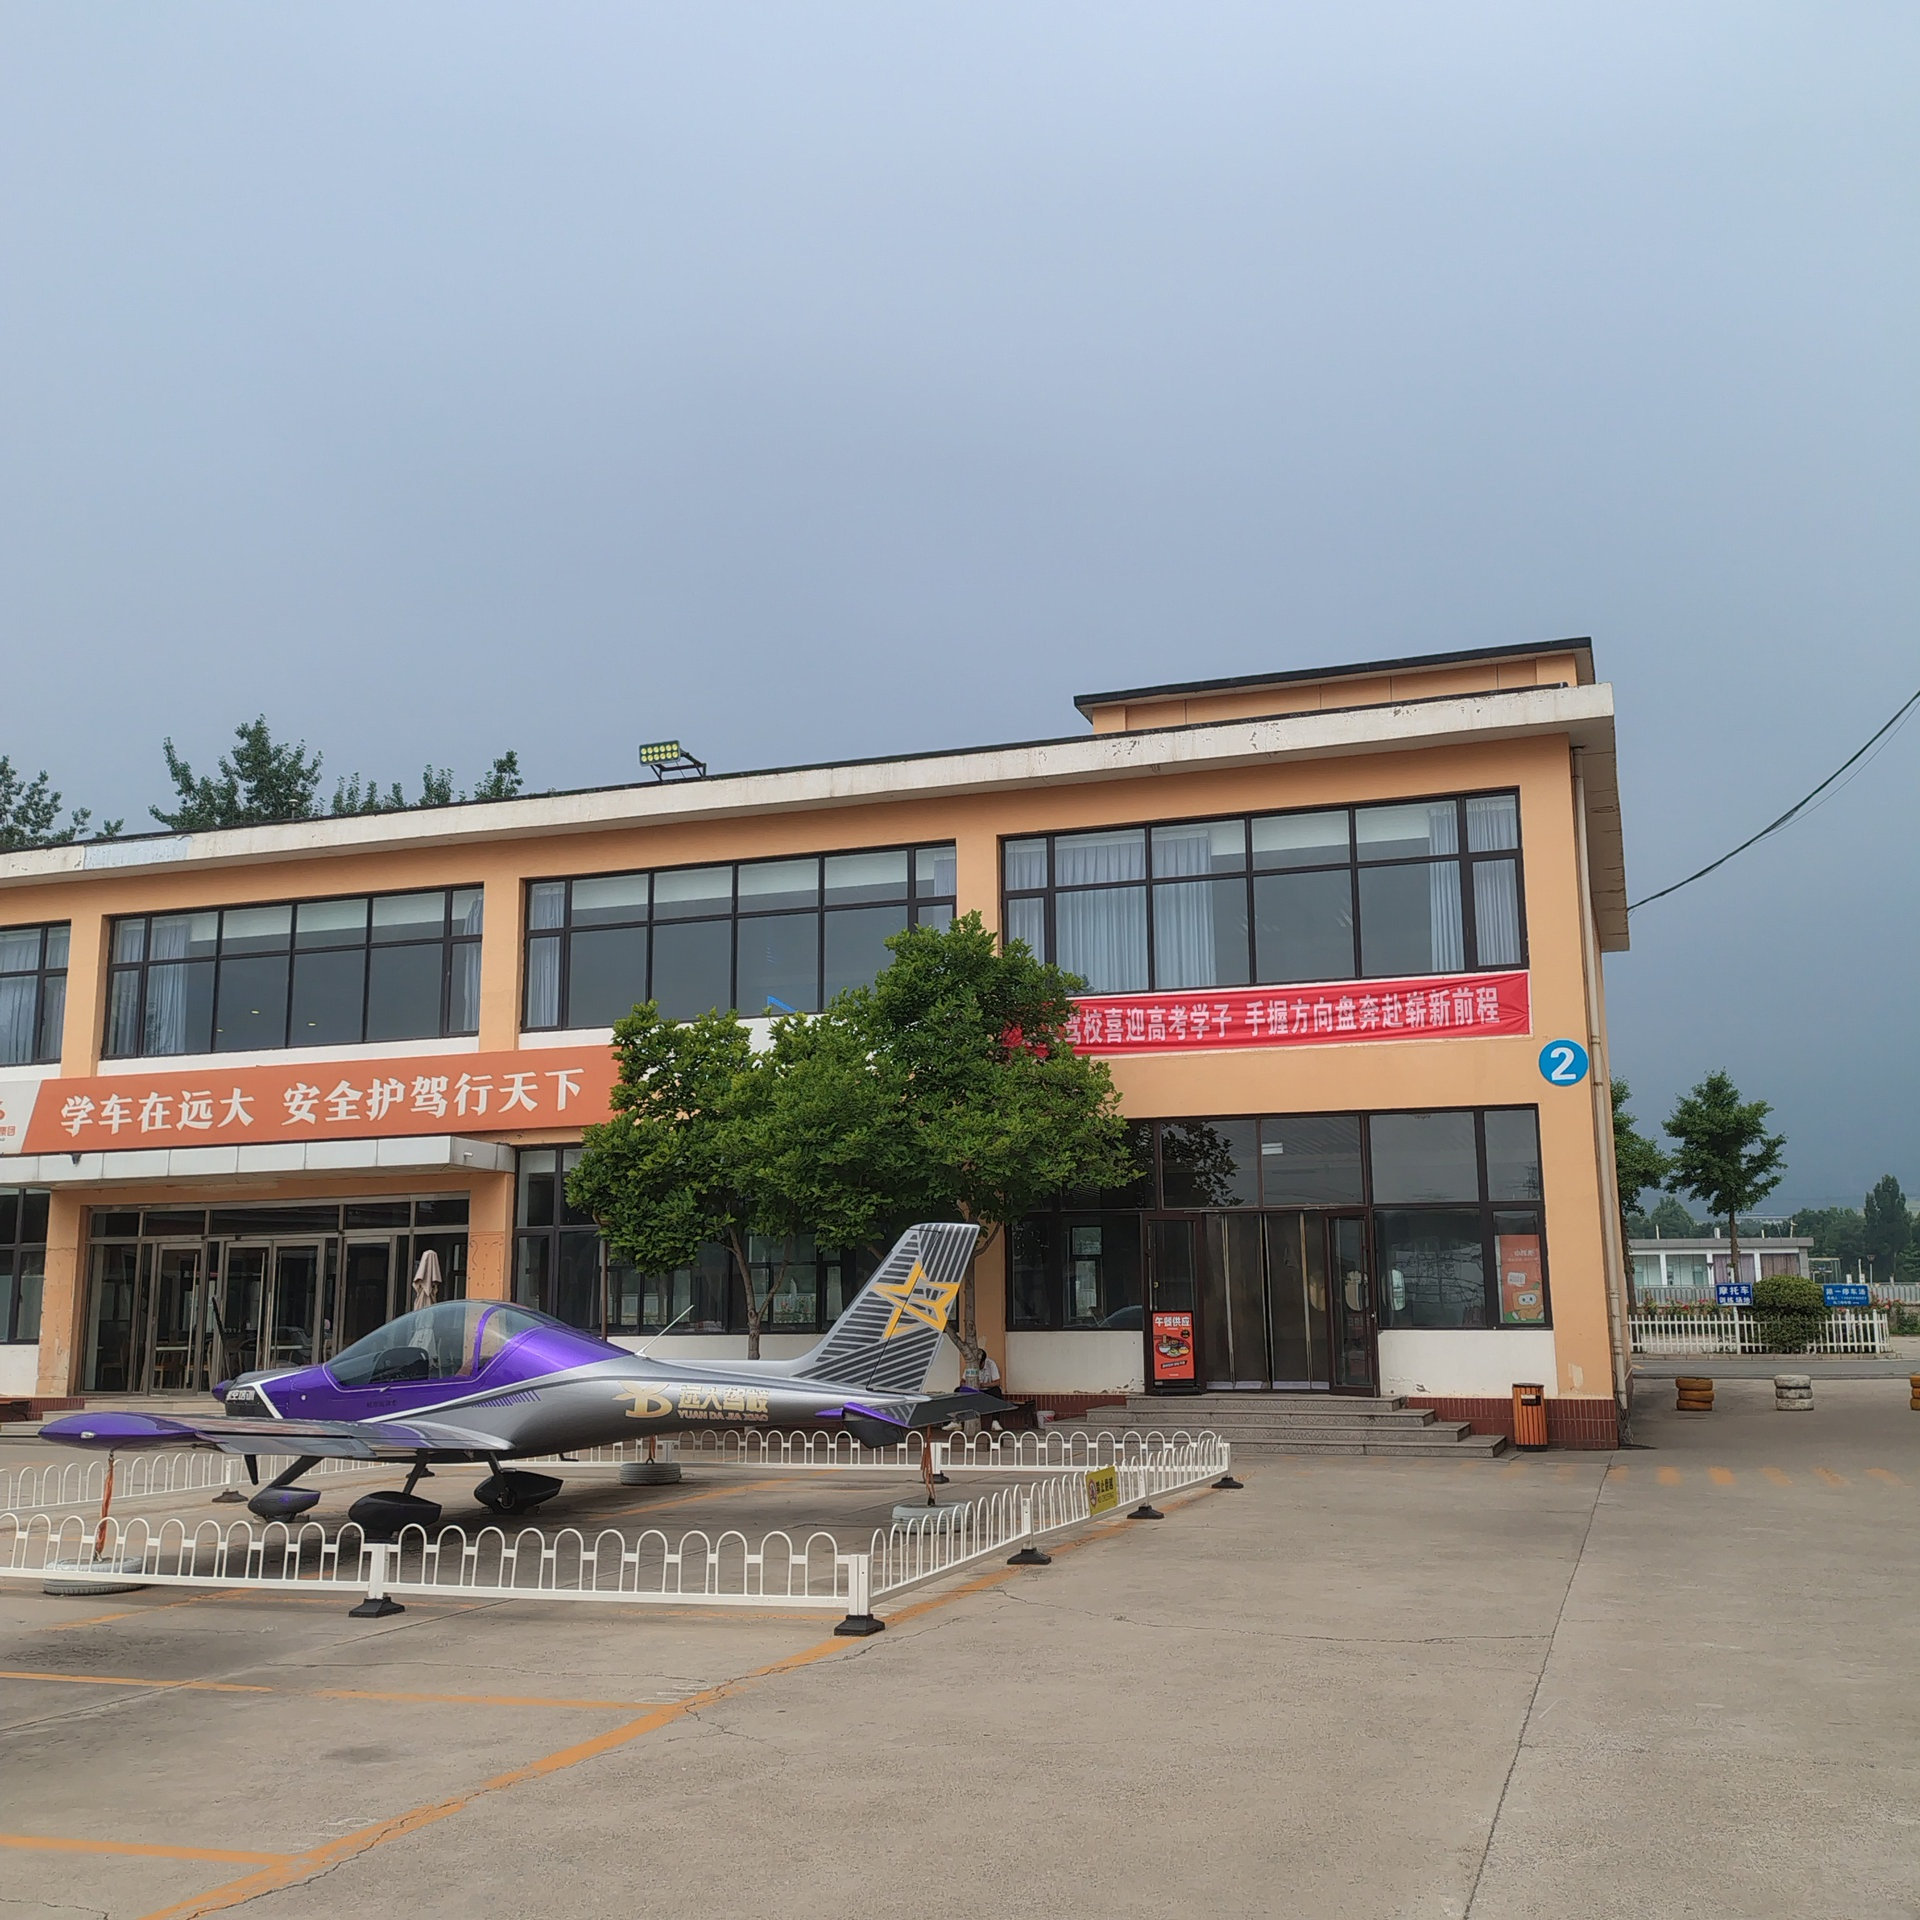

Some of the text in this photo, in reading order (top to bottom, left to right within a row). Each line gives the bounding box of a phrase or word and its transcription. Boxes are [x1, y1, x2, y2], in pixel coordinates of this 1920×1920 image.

[1047, 987, 1501, 1045] 驾校喜迎高考学子 手握方向盘奔赴崭新前程
[1549, 1047, 1577, 1081] 2
[60, 1068, 585, 1137] 学车在远大 安全护驾行天下
[1718, 1286, 1750, 1295] 摩托车
[1155, 1316, 1191, 1327] 午餐供应
[678, 1384, 769, 1413] 远大驾校
[678, 1409, 769, 1422] YUAN DA JIA XIAO
